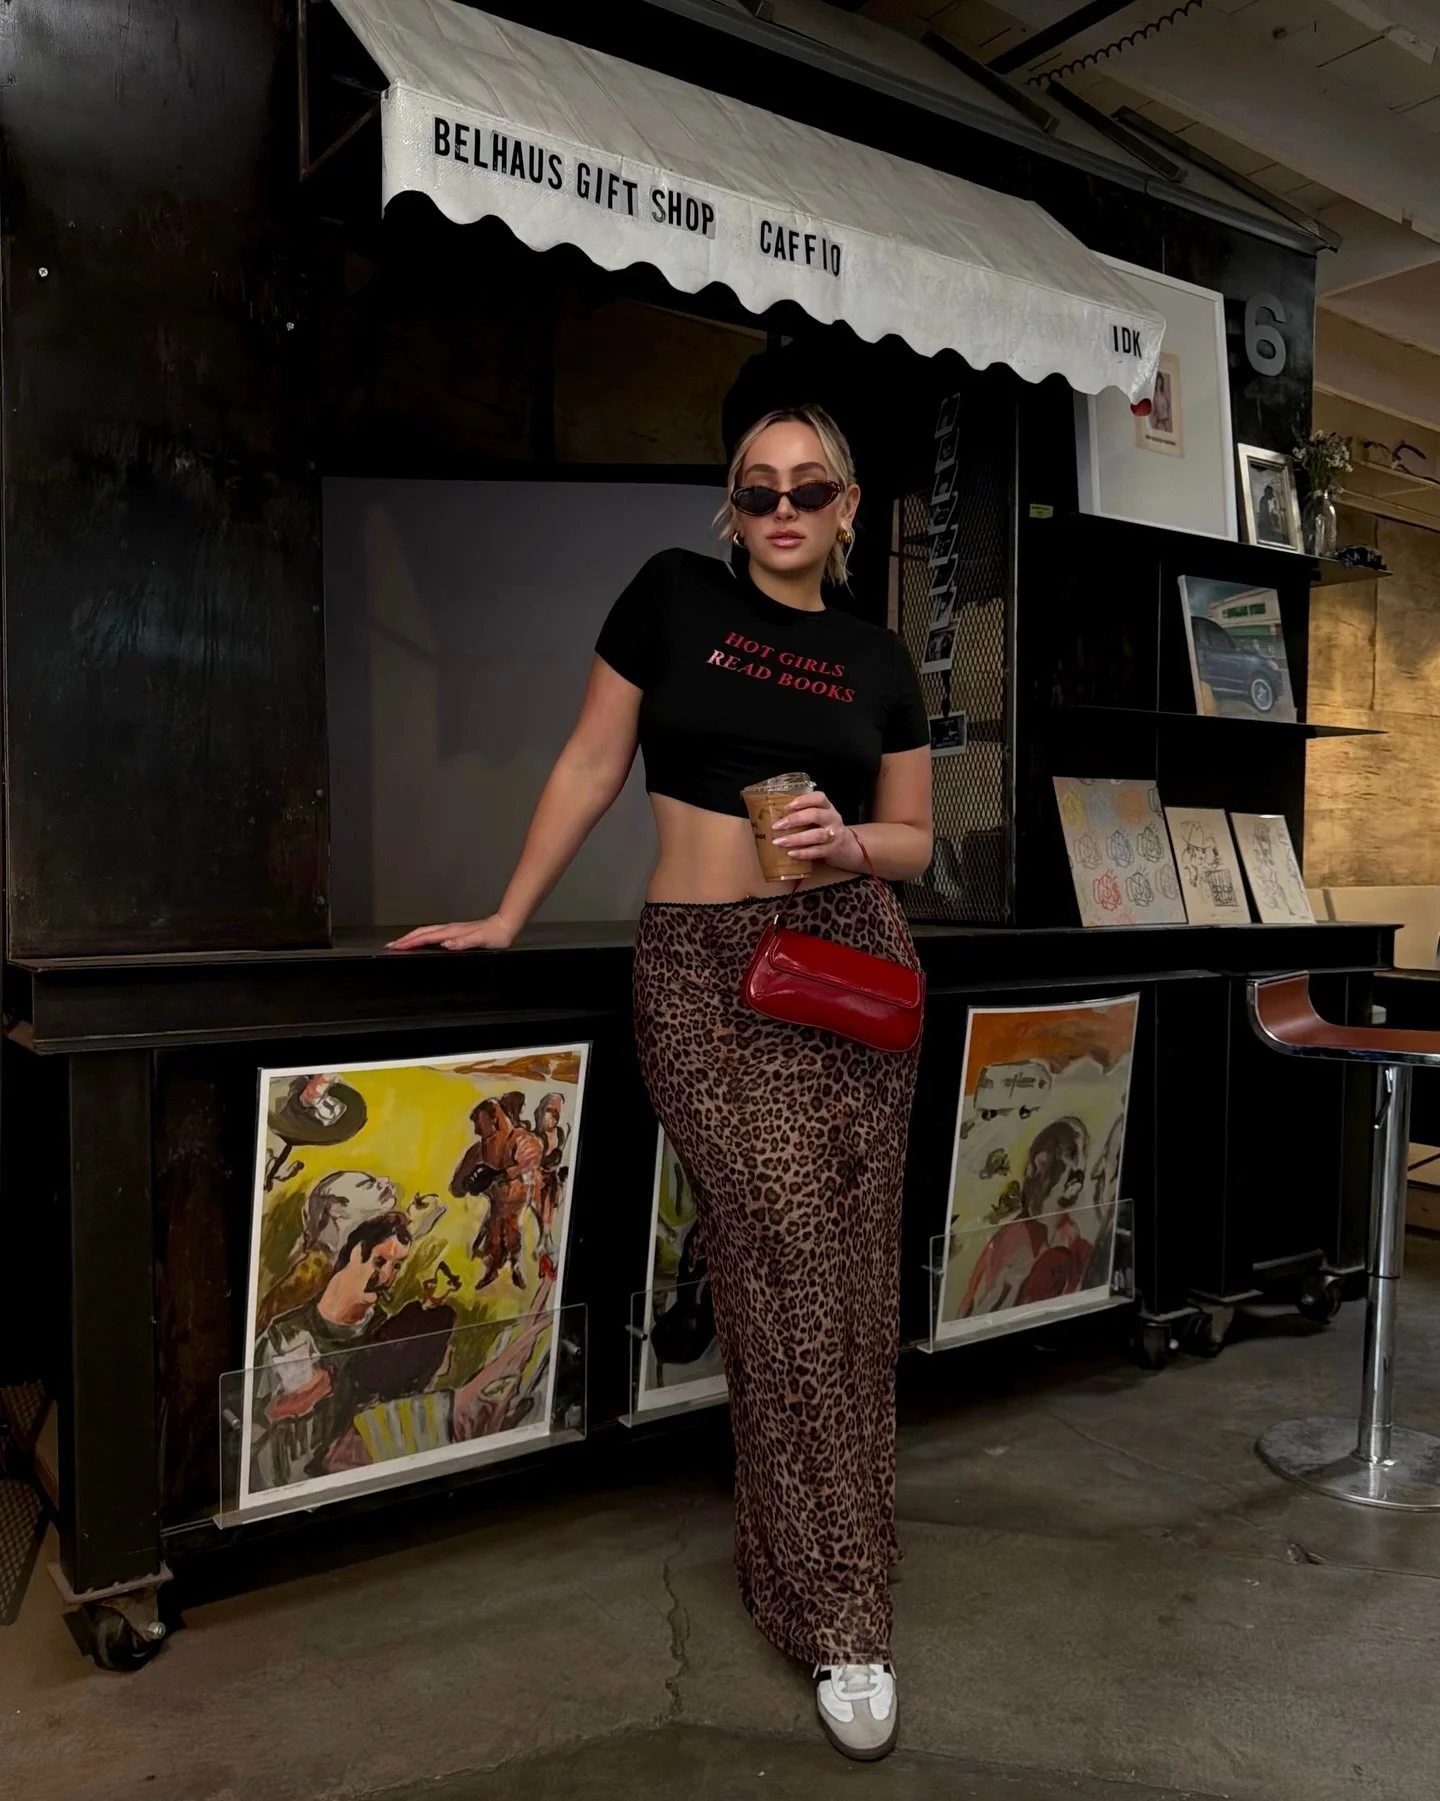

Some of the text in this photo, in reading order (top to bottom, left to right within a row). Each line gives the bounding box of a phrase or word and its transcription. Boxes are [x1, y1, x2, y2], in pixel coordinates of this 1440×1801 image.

[434, 116, 563, 190] BELHAUS
[576, 162, 638, 217] GIFT
[651, 188, 715, 236] SHOP
[1113, 325, 1143, 359] IDK
[1244, 293, 1287, 377] 6
[706, 649, 856, 703] READ BOOKS
[724, 631, 845, 678] HOT GIRLS
